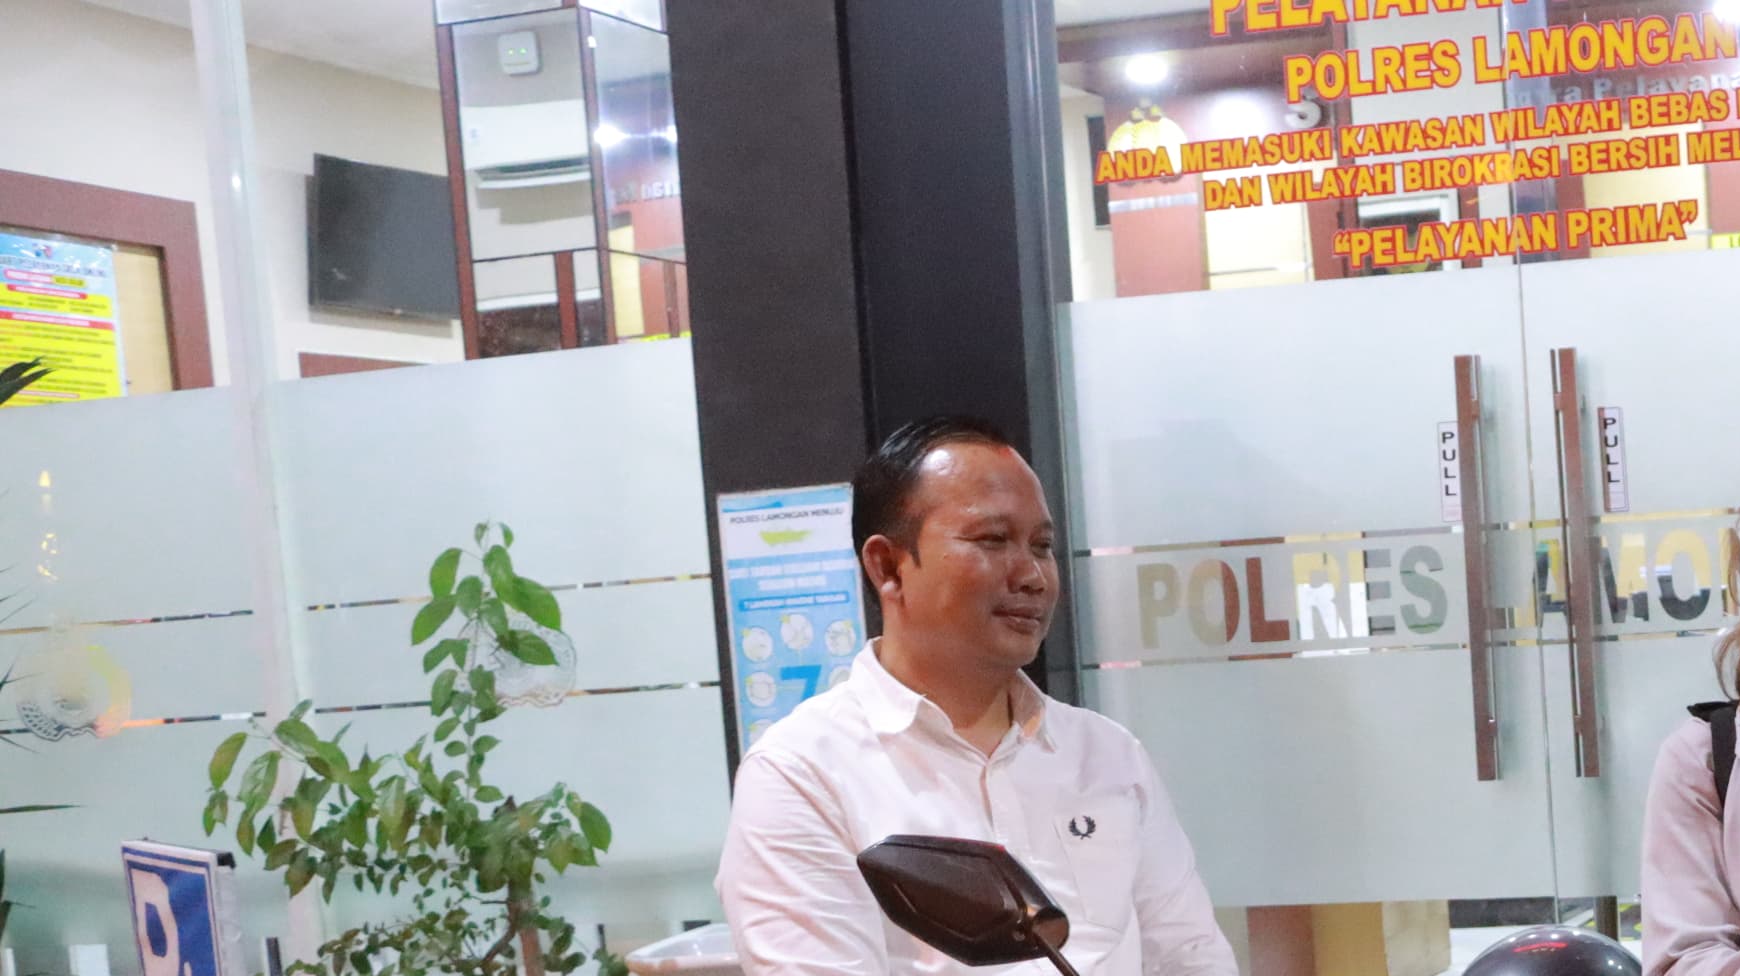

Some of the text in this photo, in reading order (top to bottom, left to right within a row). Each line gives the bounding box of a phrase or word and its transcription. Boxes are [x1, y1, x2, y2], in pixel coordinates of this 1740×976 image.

[1283, 13, 1738, 103] POLRES LAMONGAN
[1095, 149, 1175, 184] ANDA
[1181, 127, 1333, 174] MEMASUKI
[1339, 111, 1485, 159] KAWASAN
[1490, 99, 1622, 143] WILAYAH
[1630, 88, 1730, 129] BEBAS
[1203, 176, 1262, 211] DAN
[1267, 162, 1396, 205] WILAYAH
[1402, 131, 1562, 192] BIROKRASI
[1569, 127, 1682, 176] BERSIH
[1333, 199, 1698, 269] “PELAYANAN PRIMA”
[1441, 431, 1457, 496] PULL
[1602, 417, 1620, 483] PULL
[1137, 545, 1448, 649] POLRES
